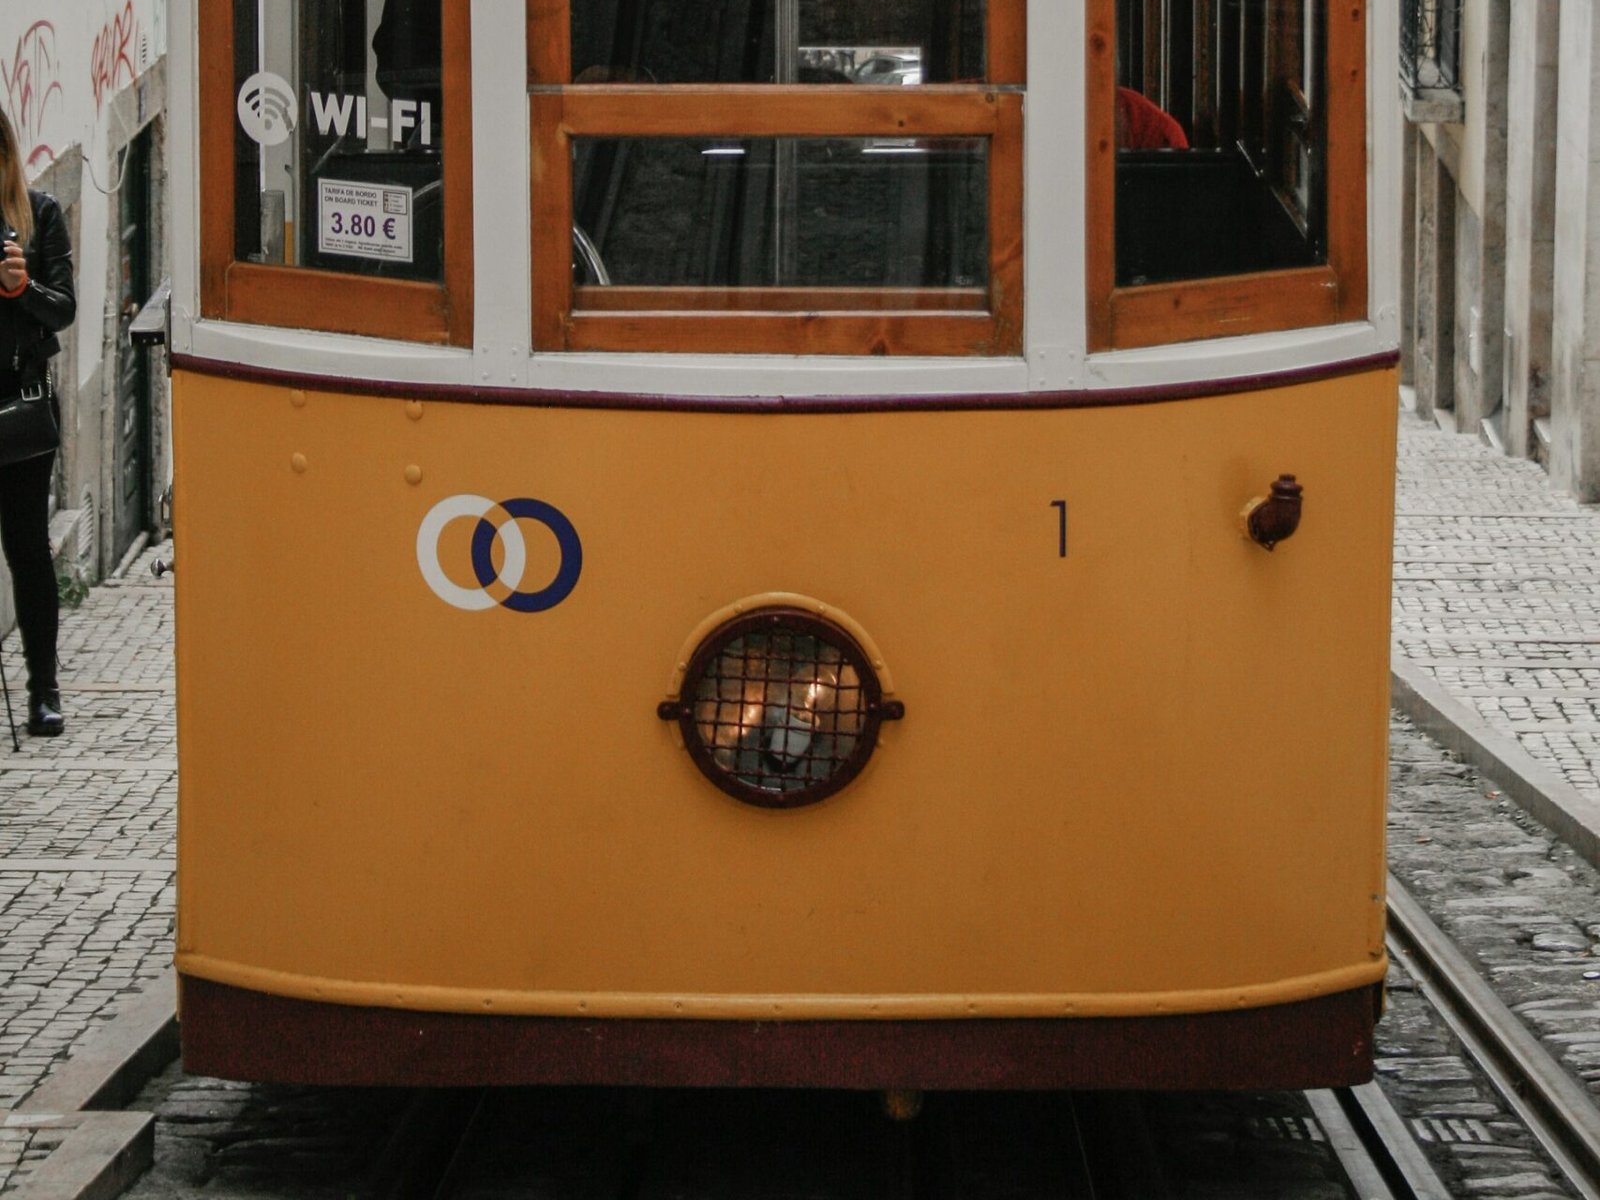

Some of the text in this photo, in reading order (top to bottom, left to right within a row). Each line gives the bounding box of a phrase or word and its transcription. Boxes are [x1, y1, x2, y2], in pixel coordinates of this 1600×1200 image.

[310, 91, 431, 146] WI-FI
[324, 187, 377, 199] TARIFA DE BORDO
[335, 196, 356, 205] BOARD
[357, 199, 378, 207] TICKET
[331, 212, 397, 240] 3.80 €
[1049, 500, 1067, 558] 1
